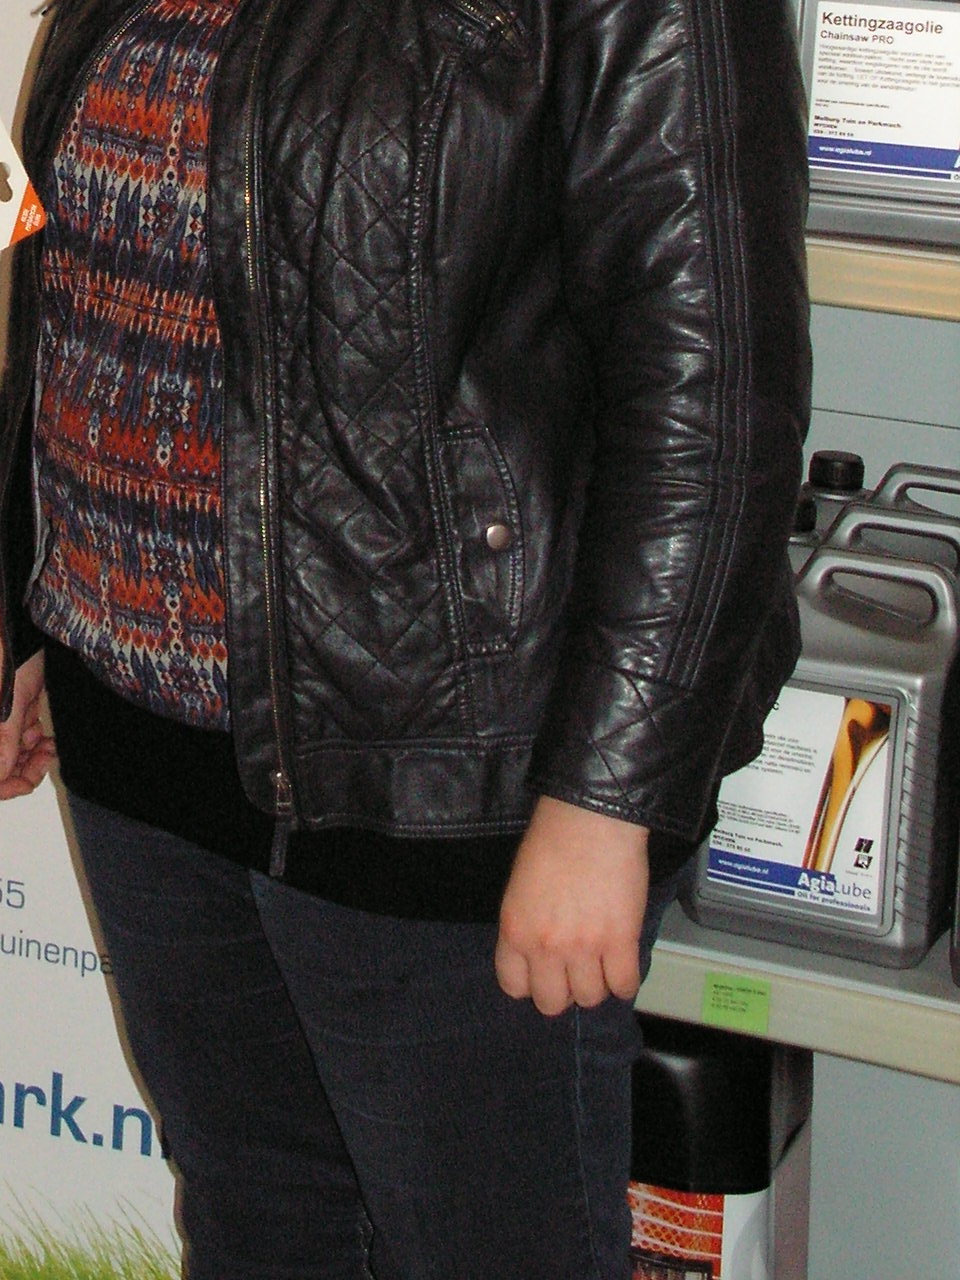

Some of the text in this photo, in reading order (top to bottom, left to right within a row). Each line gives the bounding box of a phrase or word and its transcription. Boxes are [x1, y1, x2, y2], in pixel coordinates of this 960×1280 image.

[822, 11, 943, 35] Kettingzaagolie
[820, 30, 895, 45] Chainsaw PRO
[797, 871, 872, 900] AgiaLube
